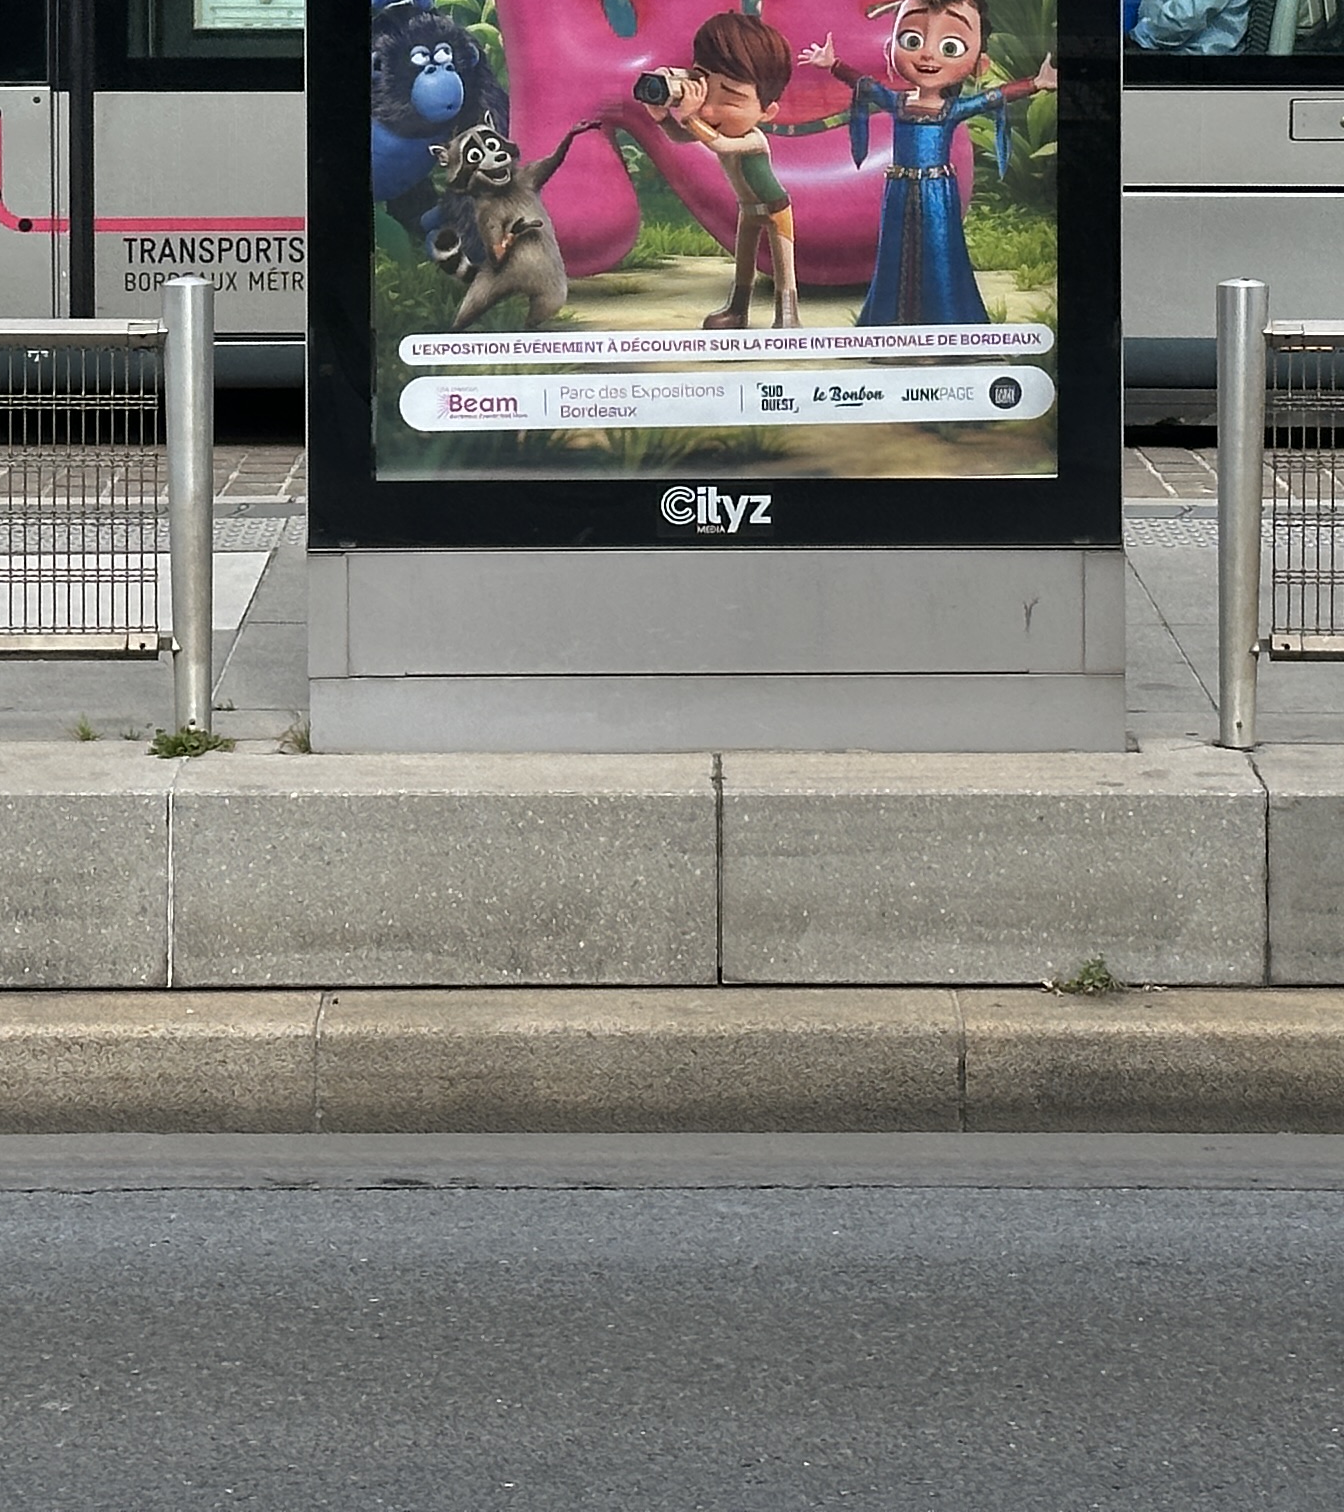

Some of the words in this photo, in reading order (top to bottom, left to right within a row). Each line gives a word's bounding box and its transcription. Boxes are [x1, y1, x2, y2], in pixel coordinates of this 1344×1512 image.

[123, 237, 305, 264] TRANSPORTS
[125, 271, 237, 292] BORUX
[249, 267, 305, 292] MÉTR
[412, 341, 510, 356] L'EXPOSITION
[513, 339, 603, 354] ÉVÉNEMENT
[607, 337, 618, 353] À
[621, 337, 706, 353] DÉCOUVRIR
[709, 338, 740, 352] SUR
[744, 338, 760, 350] LA
[764, 337, 808, 350] FOIRE
[811, 335, 935, 349] INTERNATIONALE
[938, 334, 957, 346] DE
[960, 332, 1041, 346] BORDEAUX
[560, 386, 595, 399] Parc
[599, 385, 627, 399] des
[632, 384, 725, 401] Expositions
[761, 385, 783, 398] SUD
[813, 387, 827, 402] le
[829, 385, 885, 402] Bonbon
[902, 386, 974, 401] JUNKPAGE
[449, 394, 518, 413] Beam
[560, 405, 637, 418] Bordeaux
[761, 399, 795, 412] OUEST
[661, 486, 771, 534] Cityz
[697, 525, 726, 534] MEDIA
